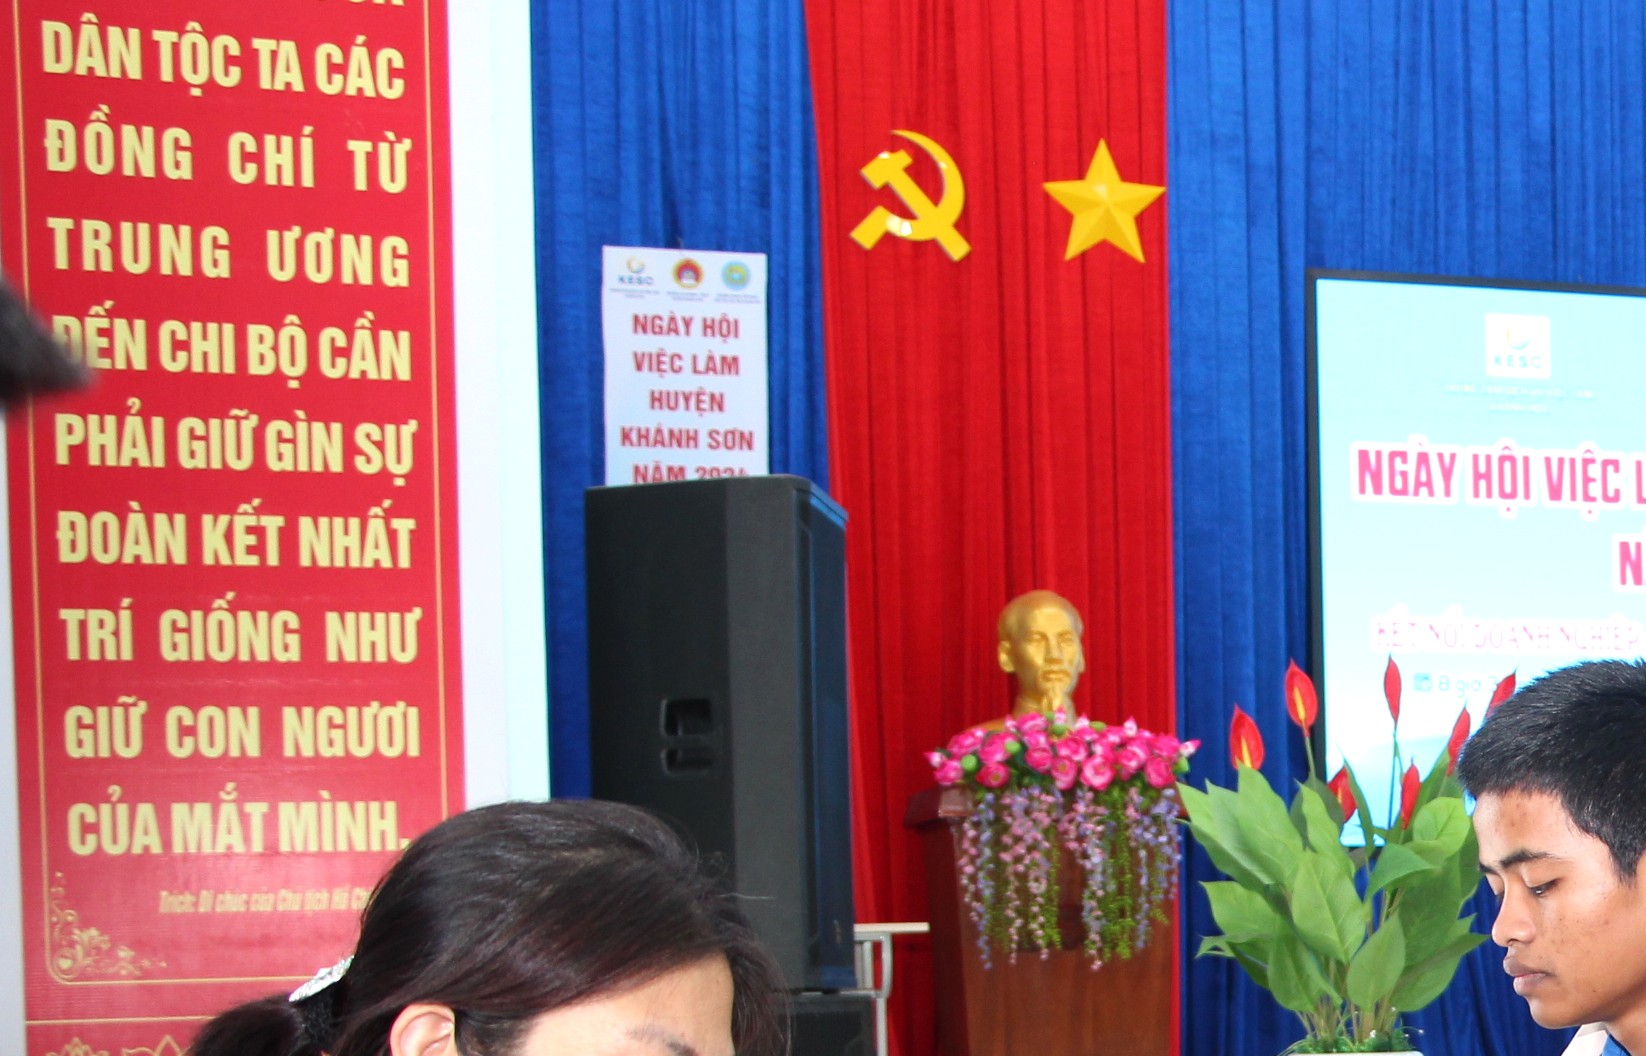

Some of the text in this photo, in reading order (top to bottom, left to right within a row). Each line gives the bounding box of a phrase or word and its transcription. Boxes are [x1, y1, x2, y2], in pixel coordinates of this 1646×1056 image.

[41, 12, 405, 100] DÂN TỘC TA CÁC
[44, 104, 412, 194] ĐỒNG CHÍ TỪ
[47, 217, 410, 287] TRUNG ƯƠNG
[159, 320, 235, 374] CHI
[247, 314, 308, 389] BỘ
[318, 311, 412, 381] CẦN
[632, 311, 739, 342] NGÀY HỘI
[632, 347, 740, 378] VIỆC LÀM
[1494, 354, 1542, 370] KESC
[649, 386, 724, 417] HUYỆN
[55, 397, 418, 486] PHẢI GIỮ GÌN SỰ
[620, 423, 754, 451] KHÁNH SƠN
[633, 461, 686, 484] NĂM
[1358, 441, 1456, 498] NGÀY
[1472, 446, 1531, 512] HỘI
[1544, 449, 1621, 514] VIỆC
[56, 498, 415, 568] ĐOÀN KẾT NHẤT
[58, 591, 422, 663] TRÍ GIỐNG NHƯ
[64, 695, 420, 758] GIỮ CON NGƯƠI
[67, 782, 411, 855] CỦA MẮT MÌNH.
